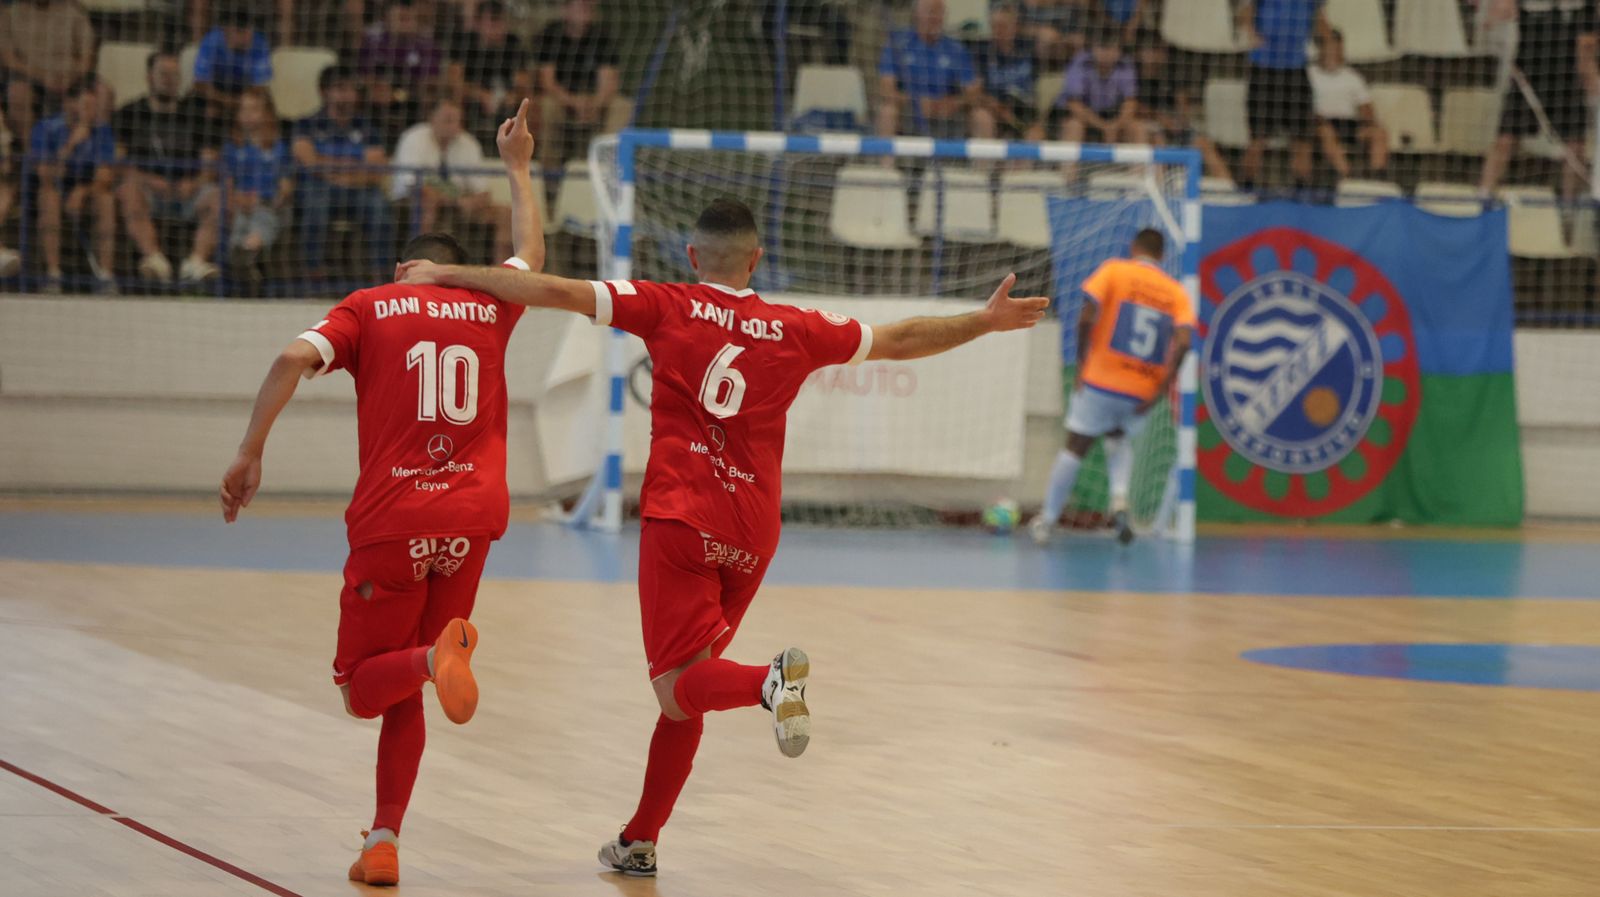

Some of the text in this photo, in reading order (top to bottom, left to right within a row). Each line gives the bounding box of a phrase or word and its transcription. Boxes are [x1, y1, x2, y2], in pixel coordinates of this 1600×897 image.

[374, 297, 497, 323] DANI SANTOS
[690, 299, 735, 331] XAVI
[1129, 307, 1161, 357] 5
[406, 341, 479, 425] 10
[698, 342, 746, 419] 6
[415, 480, 449, 492] Leyva
